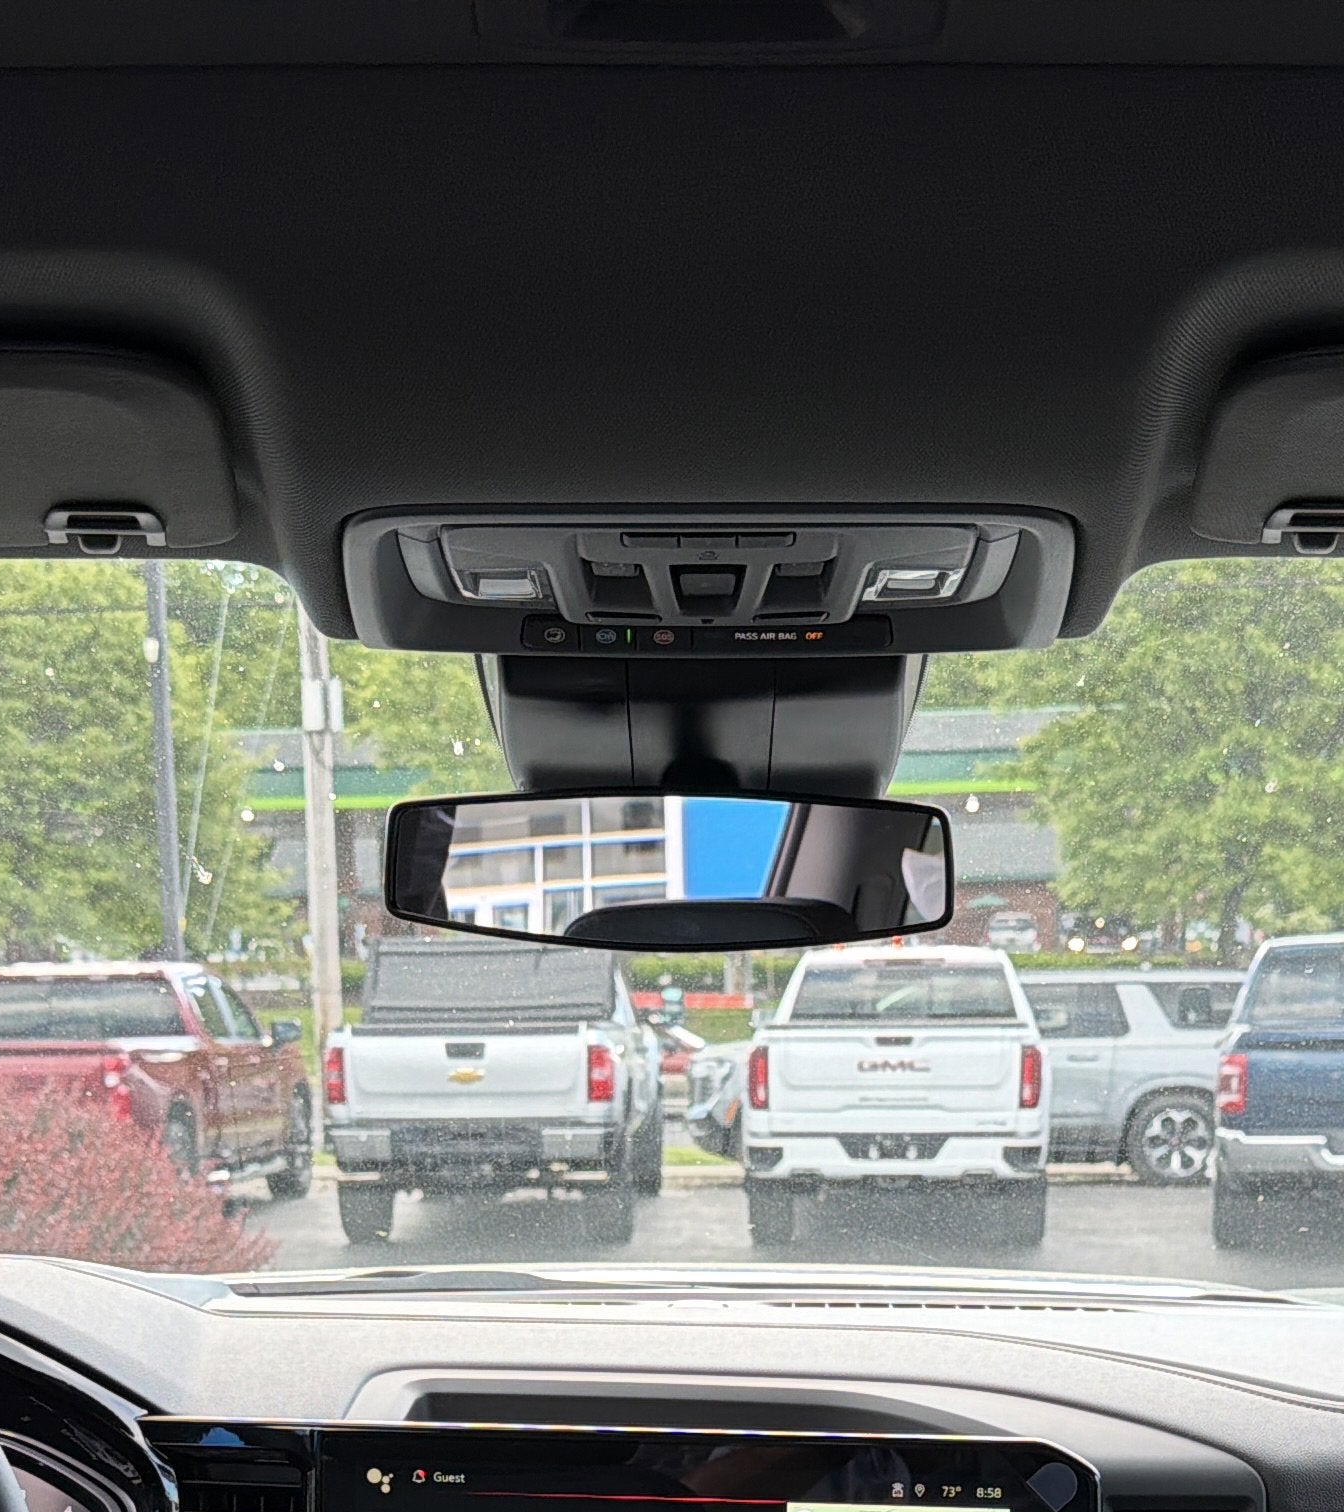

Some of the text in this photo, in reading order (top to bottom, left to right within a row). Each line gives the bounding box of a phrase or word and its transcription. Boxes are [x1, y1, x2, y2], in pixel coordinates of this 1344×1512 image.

[735, 631, 823, 641] PASS AIR BAG OFF
[857, 1059, 930, 1073] GMC
[433, 1471, 466, 1484] Guest
[941, 1485, 1002, 1498] 73° 8:58
